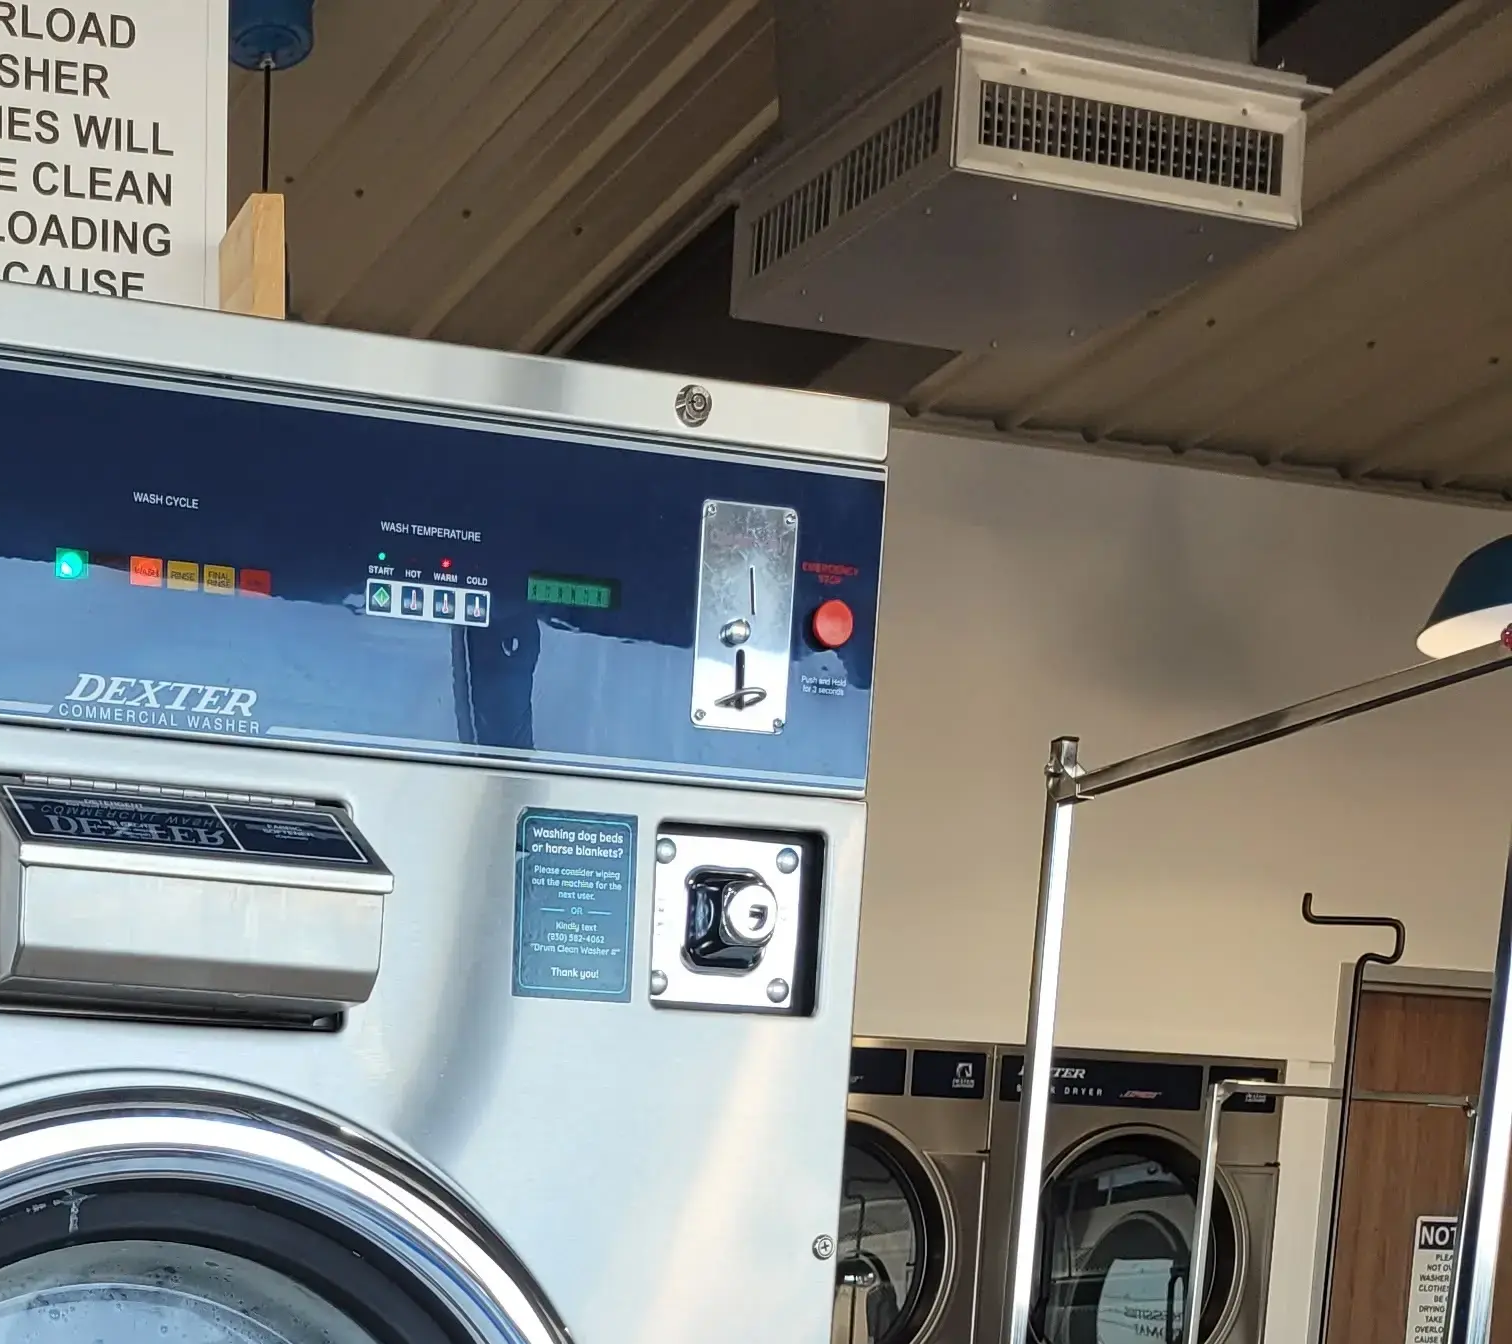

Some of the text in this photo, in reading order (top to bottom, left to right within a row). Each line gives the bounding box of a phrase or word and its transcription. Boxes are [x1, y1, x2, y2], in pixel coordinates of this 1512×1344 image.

[73, 114, 173, 156] WILL
[33, 162, 172, 206] CLEAN
[133, 492, 199, 509] WASH CYCLE
[381, 521, 481, 542] WASH TEMPERATURE
[171, 570, 195, 581] RINSE
[208, 571, 229, 580] FINAL
[369, 565, 394, 575] START
[405, 570, 421, 578] HOT
[434, 573, 457, 582] WARM
[467, 576, 487, 586] COLD
[65, 673, 256, 717] DEXTER
[59, 703, 260, 734] COMMERCIAL WASHER
[533, 827, 623, 845] Washing dog beds
[532, 842, 623, 858] or horse blankets?
[534, 865, 620, 881] Please consider wiping
[571, 907, 583, 915] OR
[556, 921, 597, 933] Kindly text
[551, 967, 599, 979] Thank you!
